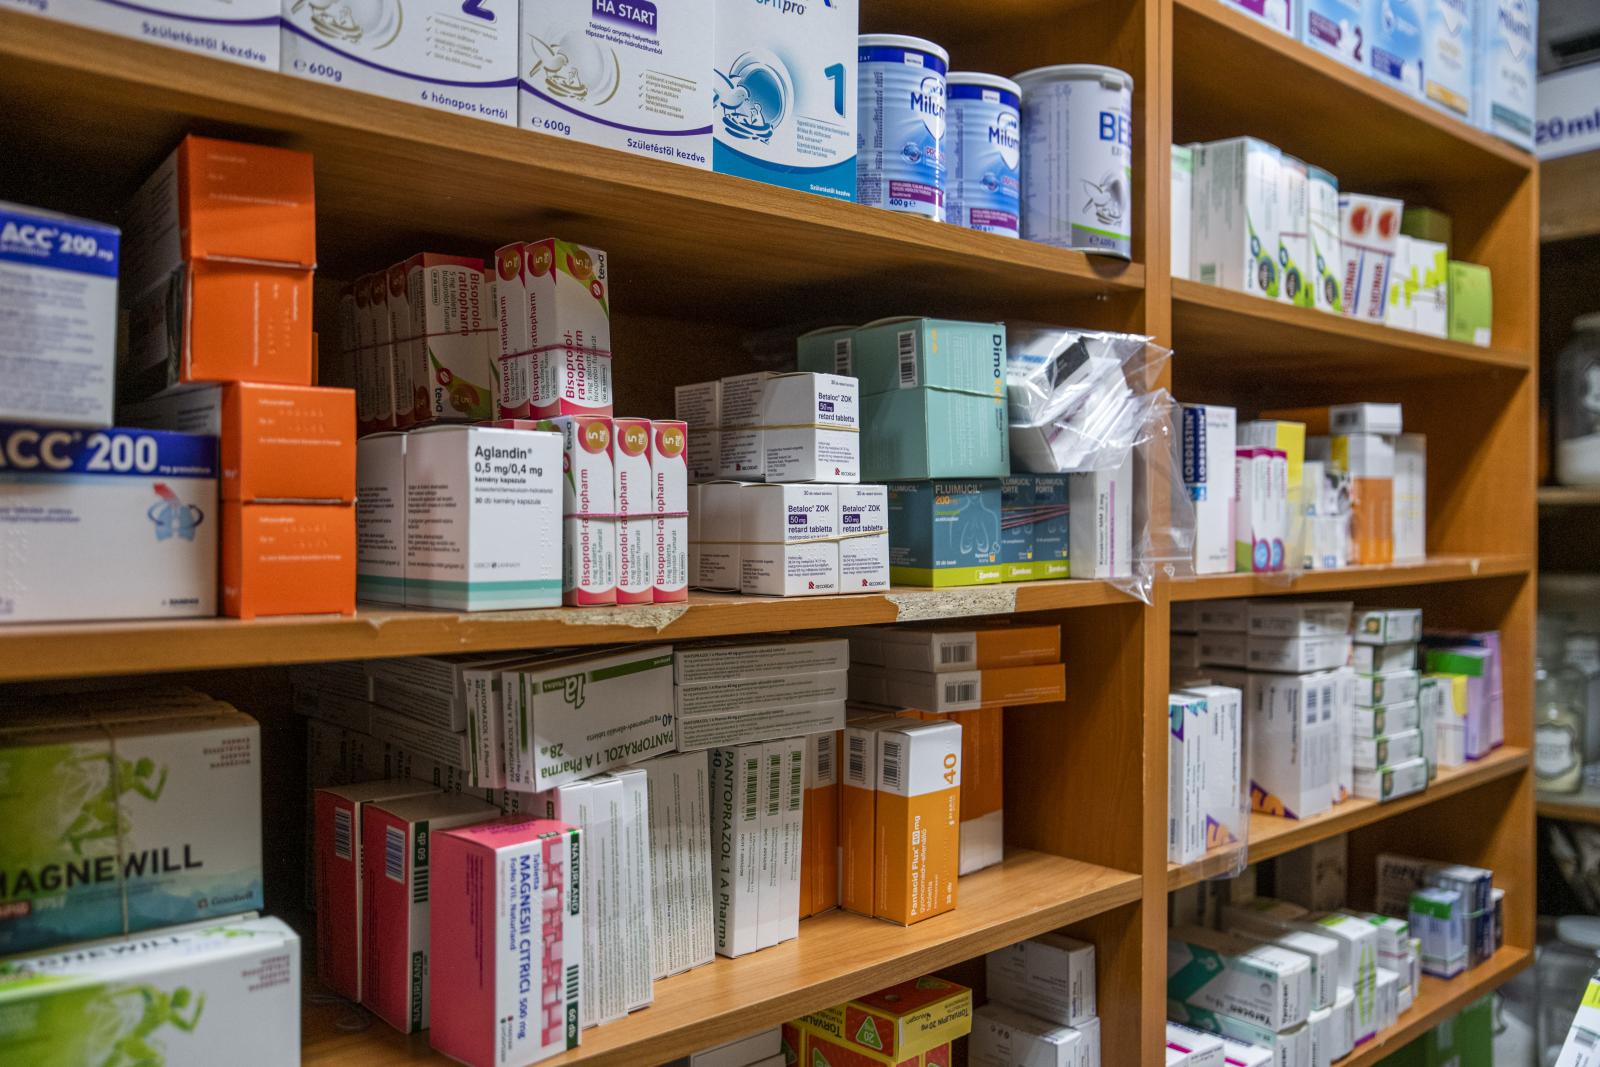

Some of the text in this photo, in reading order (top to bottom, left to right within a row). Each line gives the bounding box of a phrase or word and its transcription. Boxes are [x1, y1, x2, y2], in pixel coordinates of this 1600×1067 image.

[618, 3, 655, 26] START
[309, 61, 343, 82] 600g
[824, 62, 845, 117] 1
[420, 90, 508, 119] 6 hónapos kortól
[543, 118, 571, 136] 600g
[626, 137, 706, 165] Születéstől kezdve
[889, 198, 903, 207] 400
[59, 232, 98, 257] 200
[597, 254, 605, 279] teva
[434, 386, 443, 413] teva
[818, 413, 855, 423] retard tabletta
[589, 432, 598, 440] 5
[628, 435, 637, 443] 5
[86, 434, 158, 472] 200
[474, 461, 543, 477] 0,5 mg/0,4 mg
[934, 484, 980, 494] FLUIMUCIL
[1002, 477, 1030, 486] LUIMUCIL
[788, 525, 833, 533] retard tabletta
[790, 515, 798, 523] 50
[842, 525, 861, 533] retard
[844, 515, 852, 523] 50
[662, 713, 673, 728] 40
[549, 743, 564, 758] 28
[604, 729, 674, 762] PANTOPRAZOL
[540, 756, 582, 779] Pharma
[584, 754, 593, 768] A
[712, 749, 722, 768] 40
[943, 752, 957, 785] 40
[720, 750, 734, 862] PANTOPRAZOL
[913, 815, 921, 831] mg
[417, 831, 427, 861] 60 db
[911, 849, 919, 870] Flux
[571, 842, 580, 914] NATURLAND
[720, 878, 730, 888] A
[911, 872, 920, 917] Pantacid
[509, 904, 518, 951] Naturland
[717, 892, 730, 948] Pharma
[517, 854, 530, 1039] MAGNESII CITRICI 500 mg
[413, 955, 422, 1023] NATURLAND
[568, 1008, 577, 1037] 60 db
[928, 1019, 937, 1030] 20
[863, 1031, 874, 1043] 20
